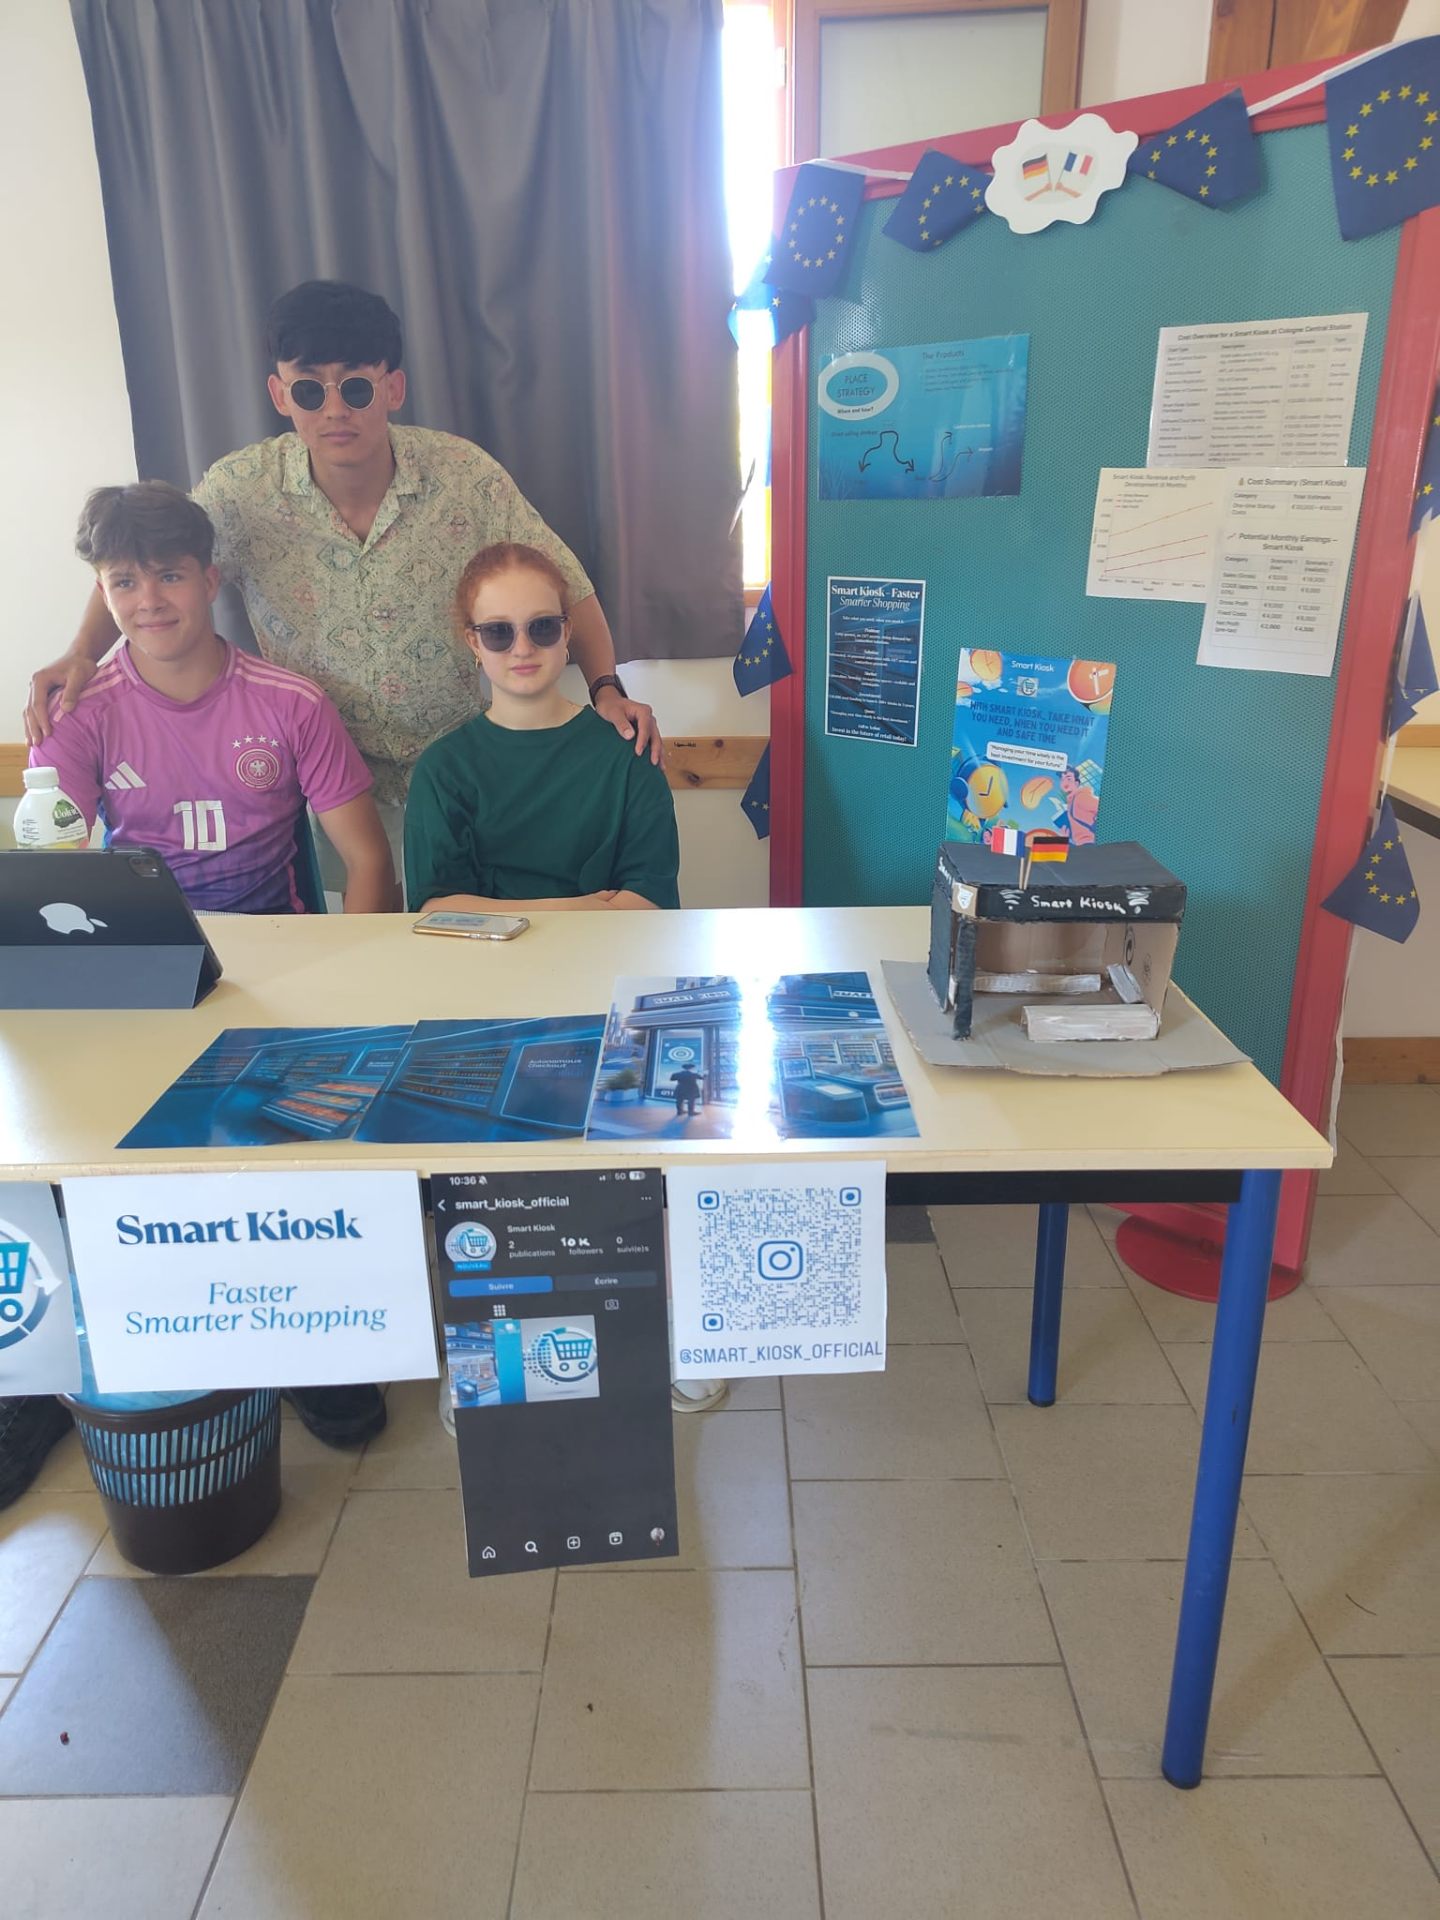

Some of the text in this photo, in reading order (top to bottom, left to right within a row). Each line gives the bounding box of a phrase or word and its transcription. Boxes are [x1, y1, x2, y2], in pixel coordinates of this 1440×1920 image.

[844, 374, 868, 384] PLACE
[838, 386, 874, 398] STRATEGY
[1270, 534, 1298, 542] Monthly
[832, 585, 858, 596] Smart
[860, 586, 885, 597] Kiosk
[892, 588, 920, 599] Faster
[840, 596, 910, 612] Smarter Shopping
[1012, 660, 1054, 672] Smart Kiosk
[970, 701, 988, 711] WITH
[990, 704, 1016, 715] SMART
[1048, 712, 1070, 722] TAKE
[1071, 714, 1094, 727] WHAT
[972, 712, 987, 721] YOU
[1014, 720, 1037, 731] WHEN
[1039, 723, 1056, 733] YOU
[1056, 725, 1080, 736] NEED
[1081, 728, 1089, 737] IT
[997, 727, 1056, 744] AND SAFE TIME
[173, 800, 227, 852] 10
[1030, 895, 1126, 914] Smart Kiosk
[449, 1176, 477, 1186] 10:36
[455, 1196, 570, 1211] smart_kiosk_official
[116, 1208, 363, 1246] Smart Kiosk
[507, 1224, 556, 1233] Smart Kiosk
[508, 1236, 623, 1249] 2 10 K 0
[509, 1249, 556, 1259] publications
[488, 1276, 618, 1291] Suivre Écrire
[208, 1280, 298, 1306] Faster
[126, 1304, 388, 1336] Smarter Shopping
[680, 1341, 883, 1364] @SMART_KIOSK_OFFICIAL
